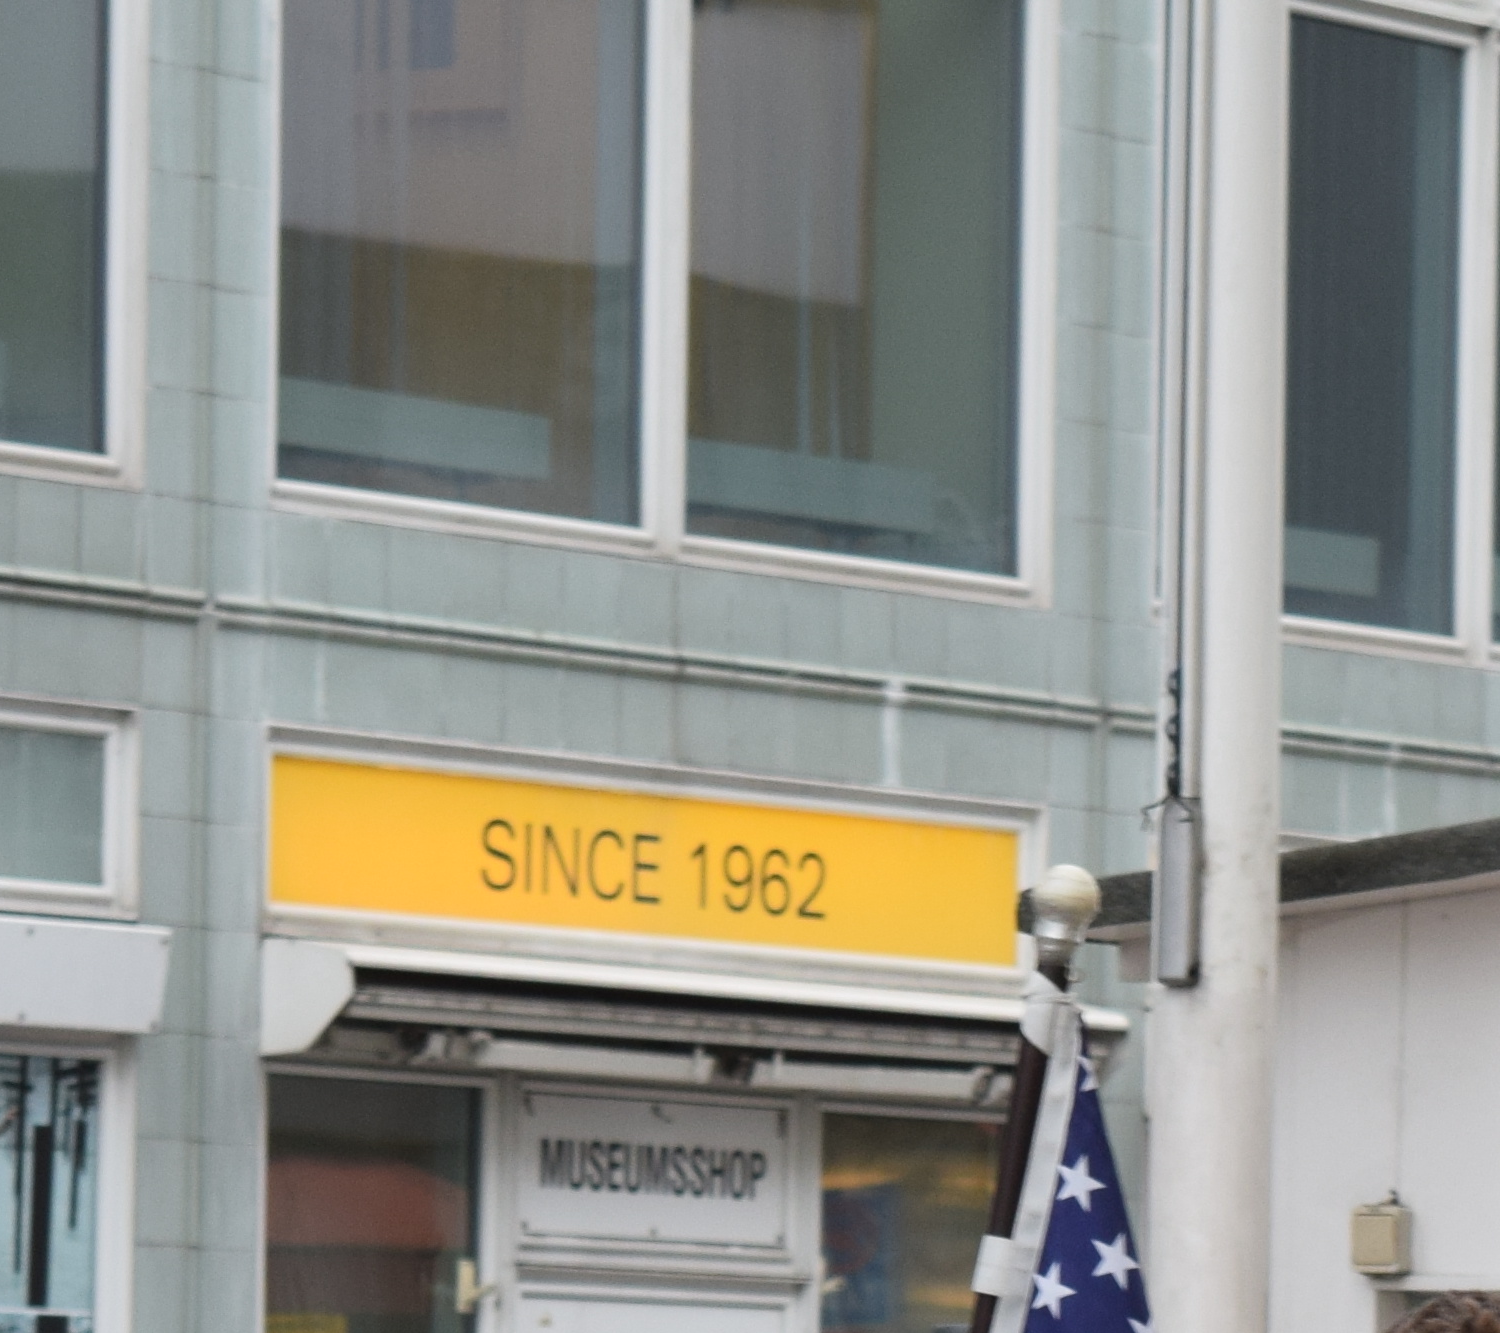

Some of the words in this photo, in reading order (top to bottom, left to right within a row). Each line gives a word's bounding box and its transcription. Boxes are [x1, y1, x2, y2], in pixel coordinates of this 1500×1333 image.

[480, 819, 662, 906] SINCE
[688, 842, 828, 922] 1962
[539, 1137, 767, 1202] MUSEUMSSHOP
